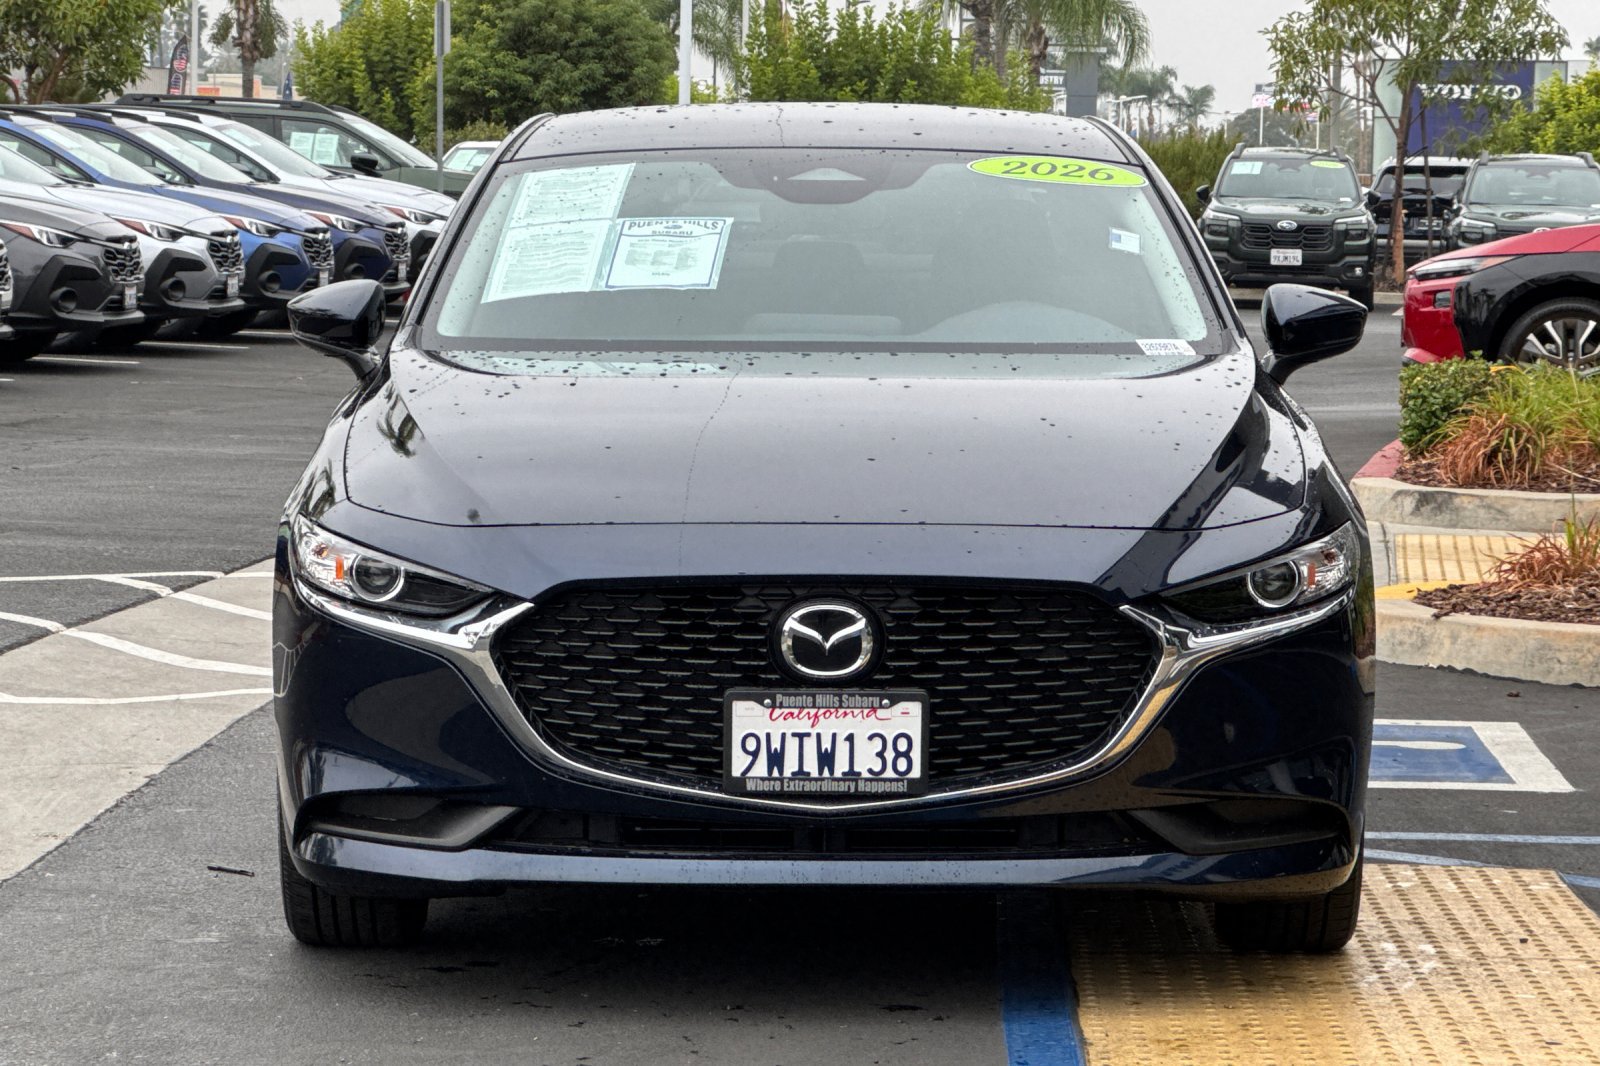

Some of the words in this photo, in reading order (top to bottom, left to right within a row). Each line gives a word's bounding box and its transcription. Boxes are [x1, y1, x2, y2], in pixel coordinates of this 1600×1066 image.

[1001, 161, 1115, 181] 2026
[628, 220, 679, 231] PUENTE
[683, 219, 719, 231] HILLS
[775, 693, 813, 708] Puente
[815, 693, 839, 708] Hills
[841, 694, 881, 708] Subaru
[768, 707, 892, 728] California
[740, 732, 913, 777] 9WIW138
[745, 778, 781, 792] Where
[783, 778, 855, 793] Extraordinary
[857, 778, 908, 793] Happens!
